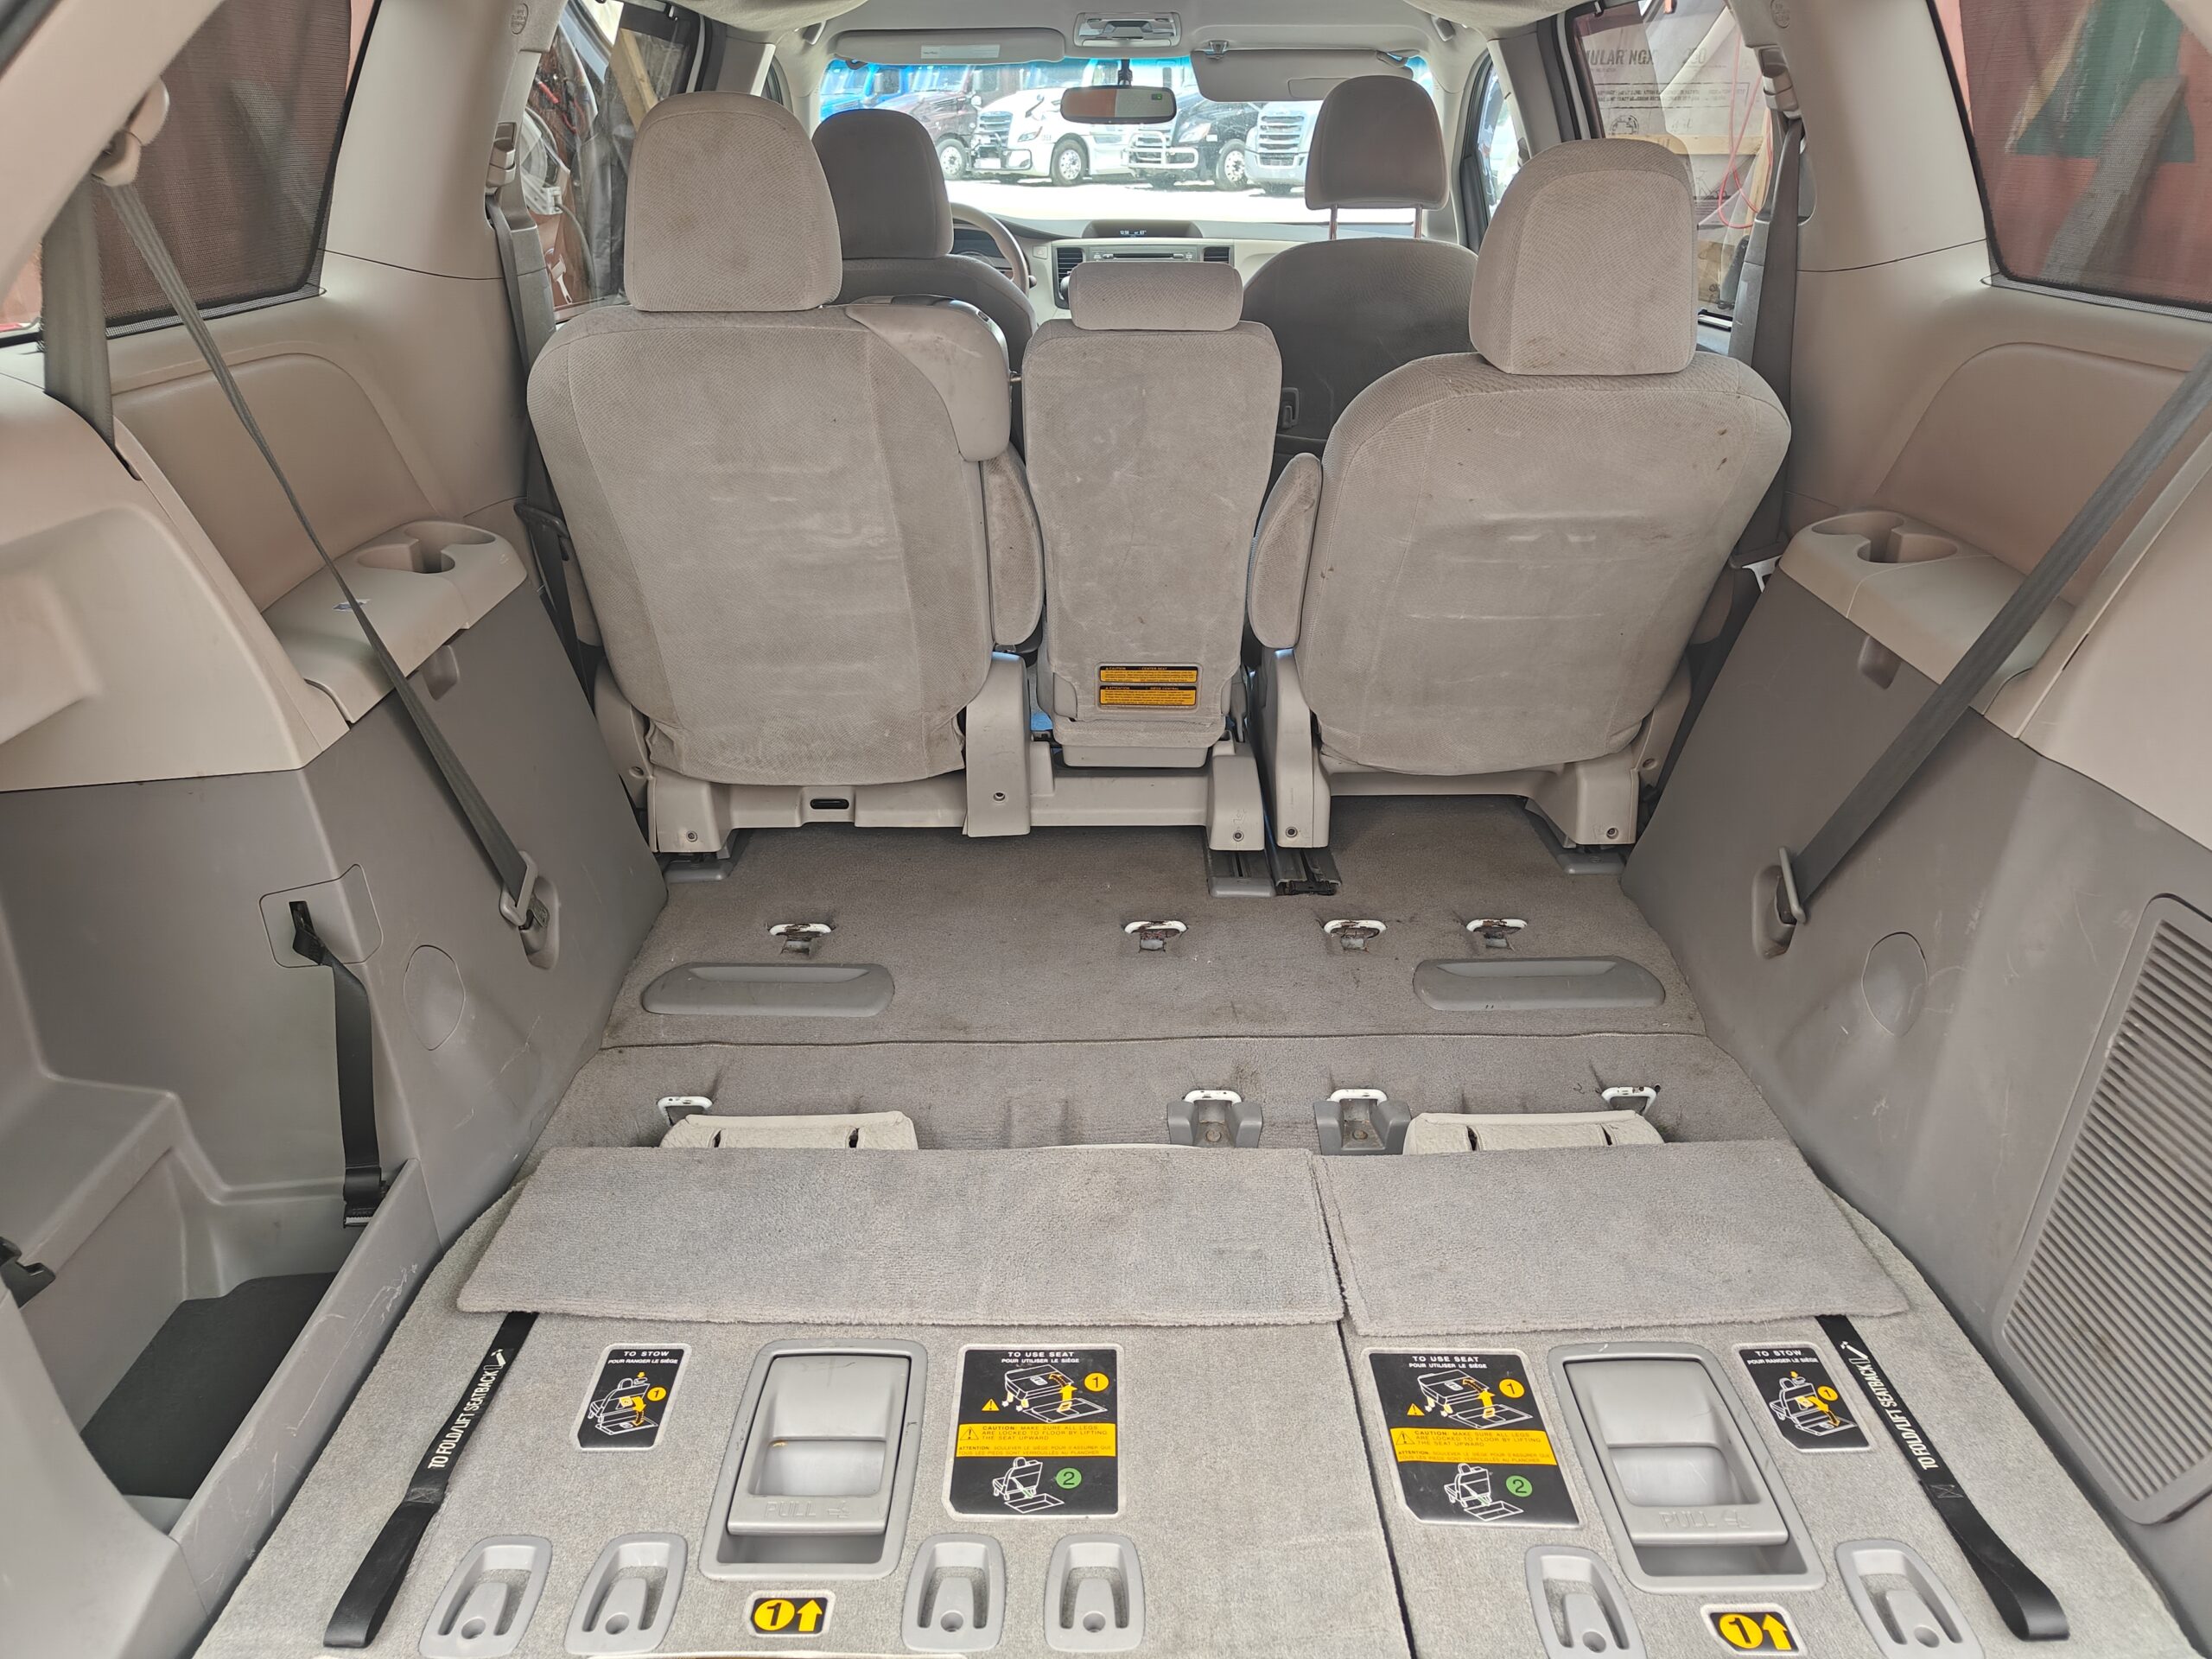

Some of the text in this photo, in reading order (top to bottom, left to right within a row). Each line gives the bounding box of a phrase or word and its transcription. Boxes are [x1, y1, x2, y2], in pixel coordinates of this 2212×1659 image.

[1093, 1377, 1100, 1389] 1
[1507, 1383, 1515, 1394] 1
[427, 1370, 499, 1470] TO FOLD/LIFT SEATBACK
[1858, 1363, 1939, 1471] TO FOLD/LIFT SEATBACK
[1064, 1471, 1075, 1484] 2
[1513, 1479, 1527, 1493] 2
[764, 1501, 817, 1518] PULL
[1659, 1511, 1718, 1529] PULL
[766, 1602, 782, 1626] 1
[1728, 1618, 1751, 1644] 1
